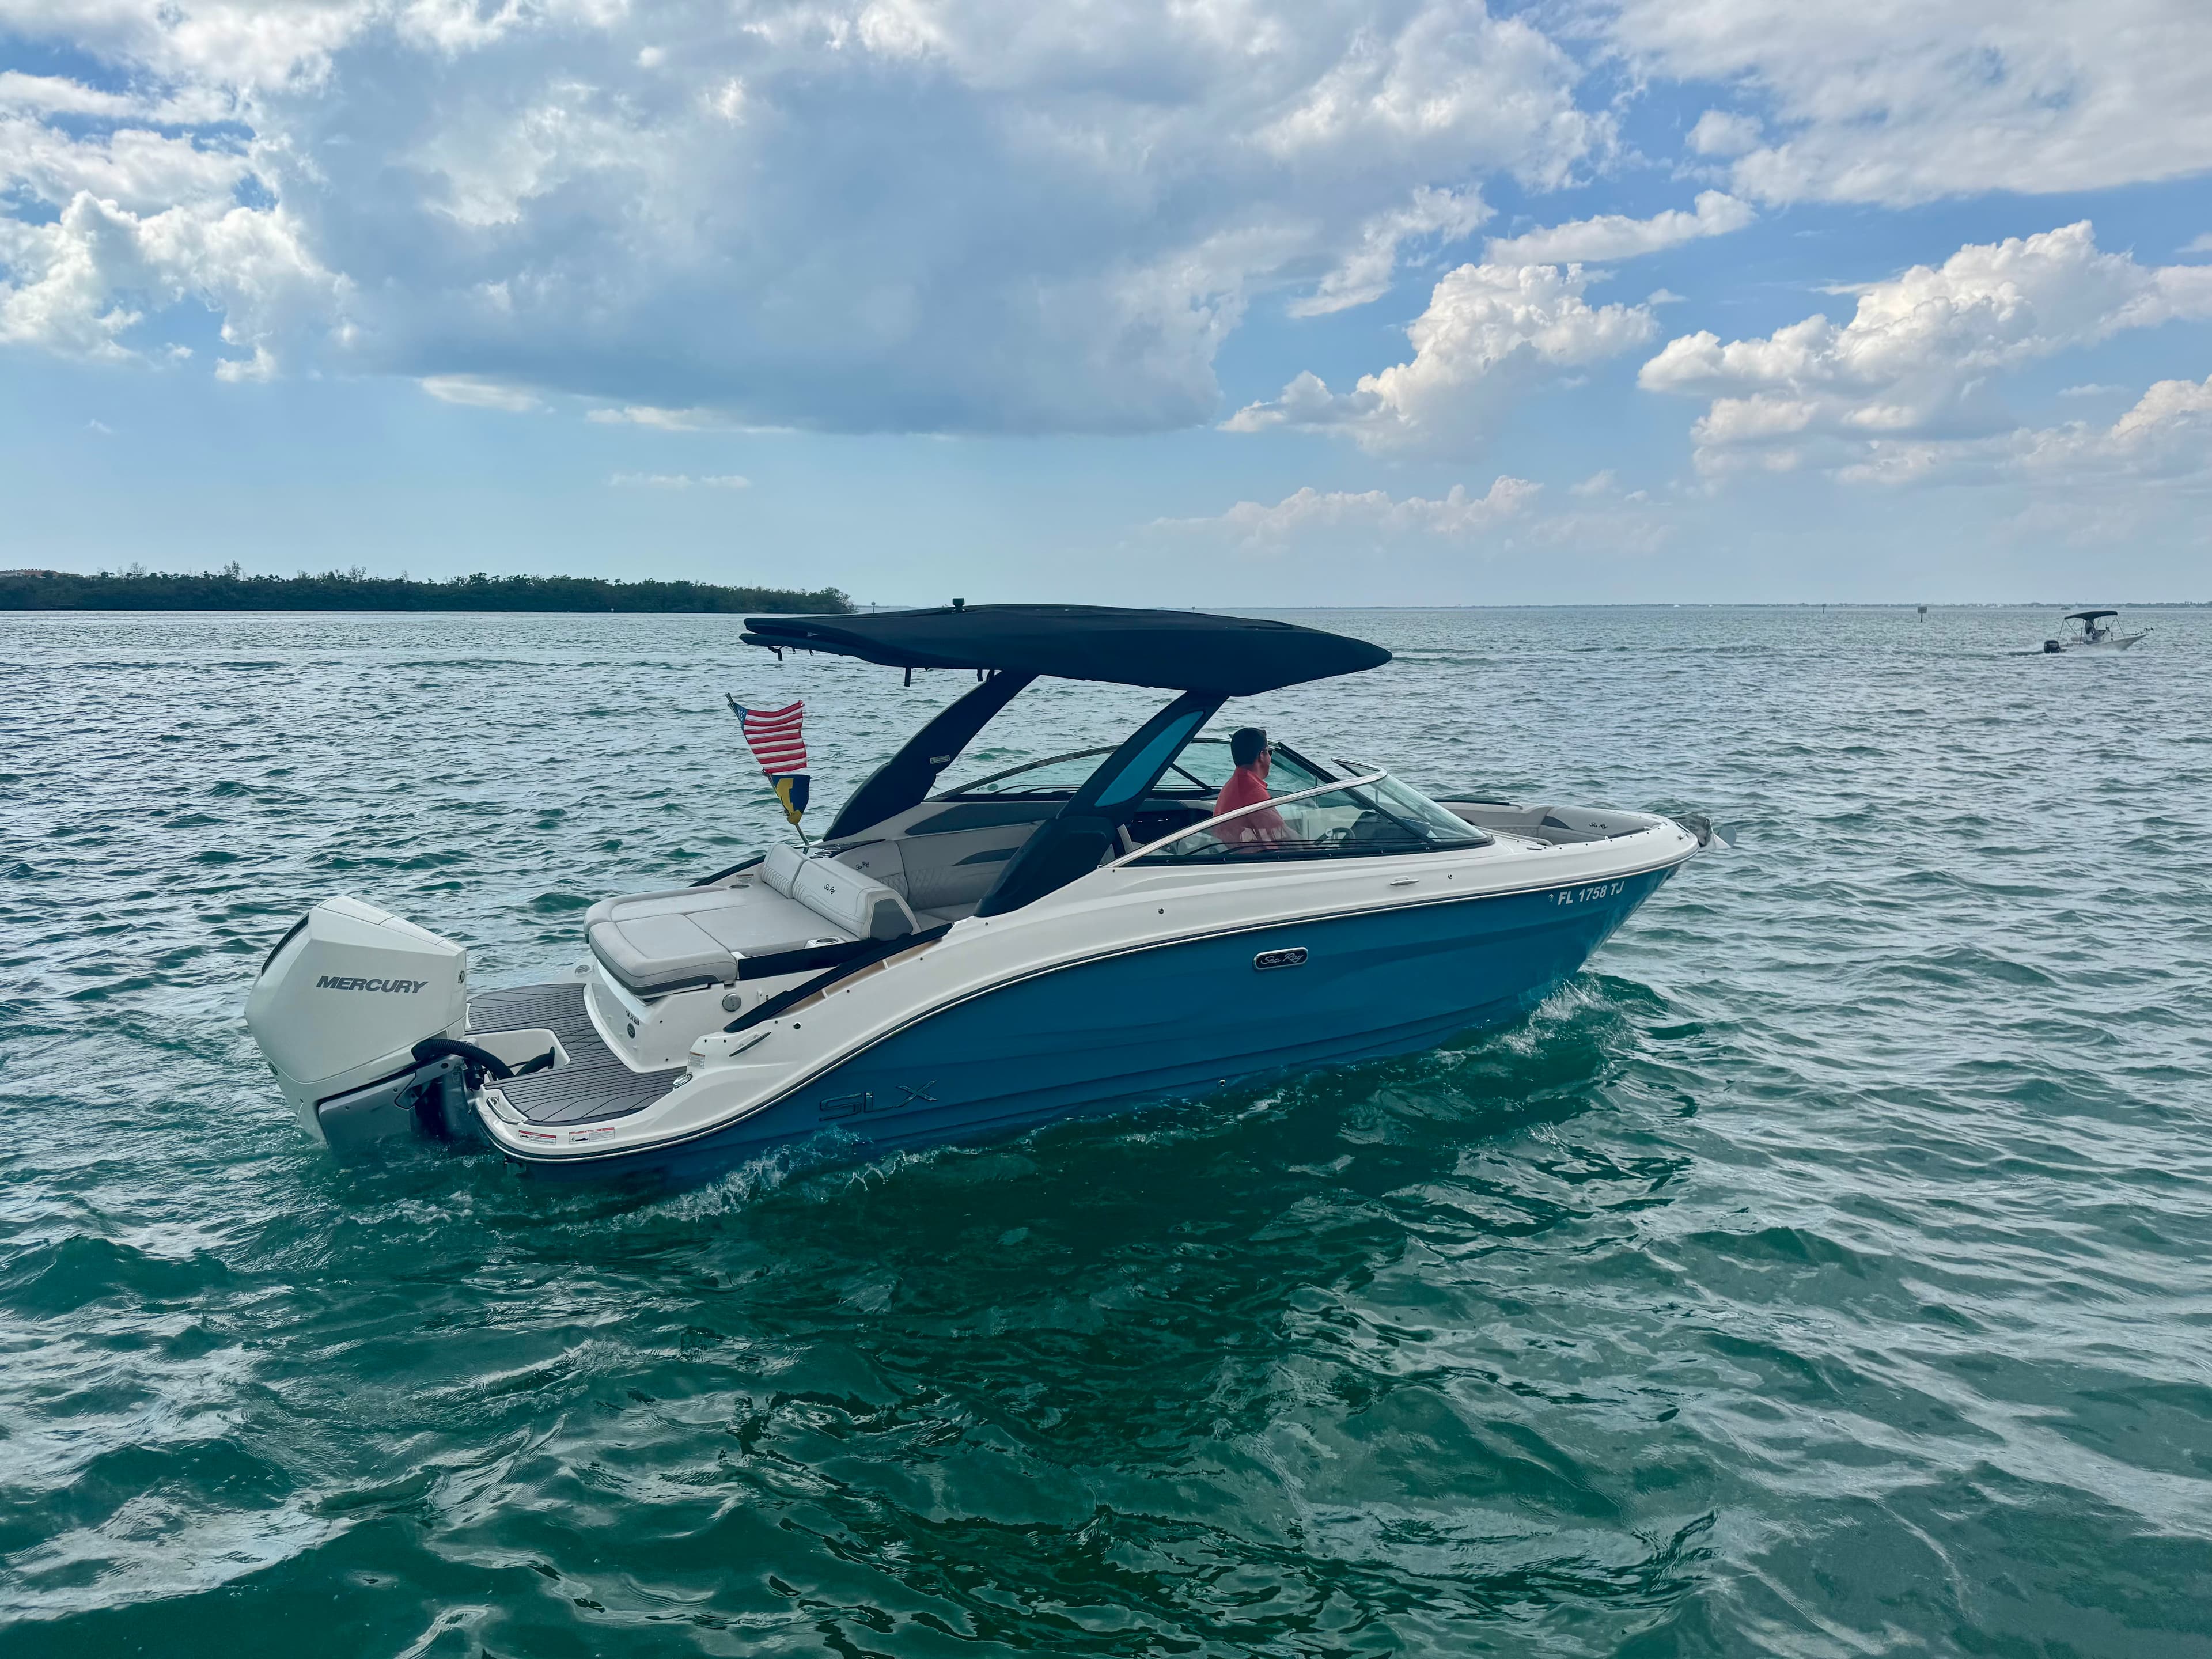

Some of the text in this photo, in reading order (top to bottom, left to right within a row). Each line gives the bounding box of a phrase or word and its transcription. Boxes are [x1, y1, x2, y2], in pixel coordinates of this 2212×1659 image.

[1558, 881, 1624, 906] FL 1758 TJ
[1260, 953, 1304, 964] Sea Ray
[316, 975, 429, 993] MERCURY
[819, 1079, 938, 1122] SLX
